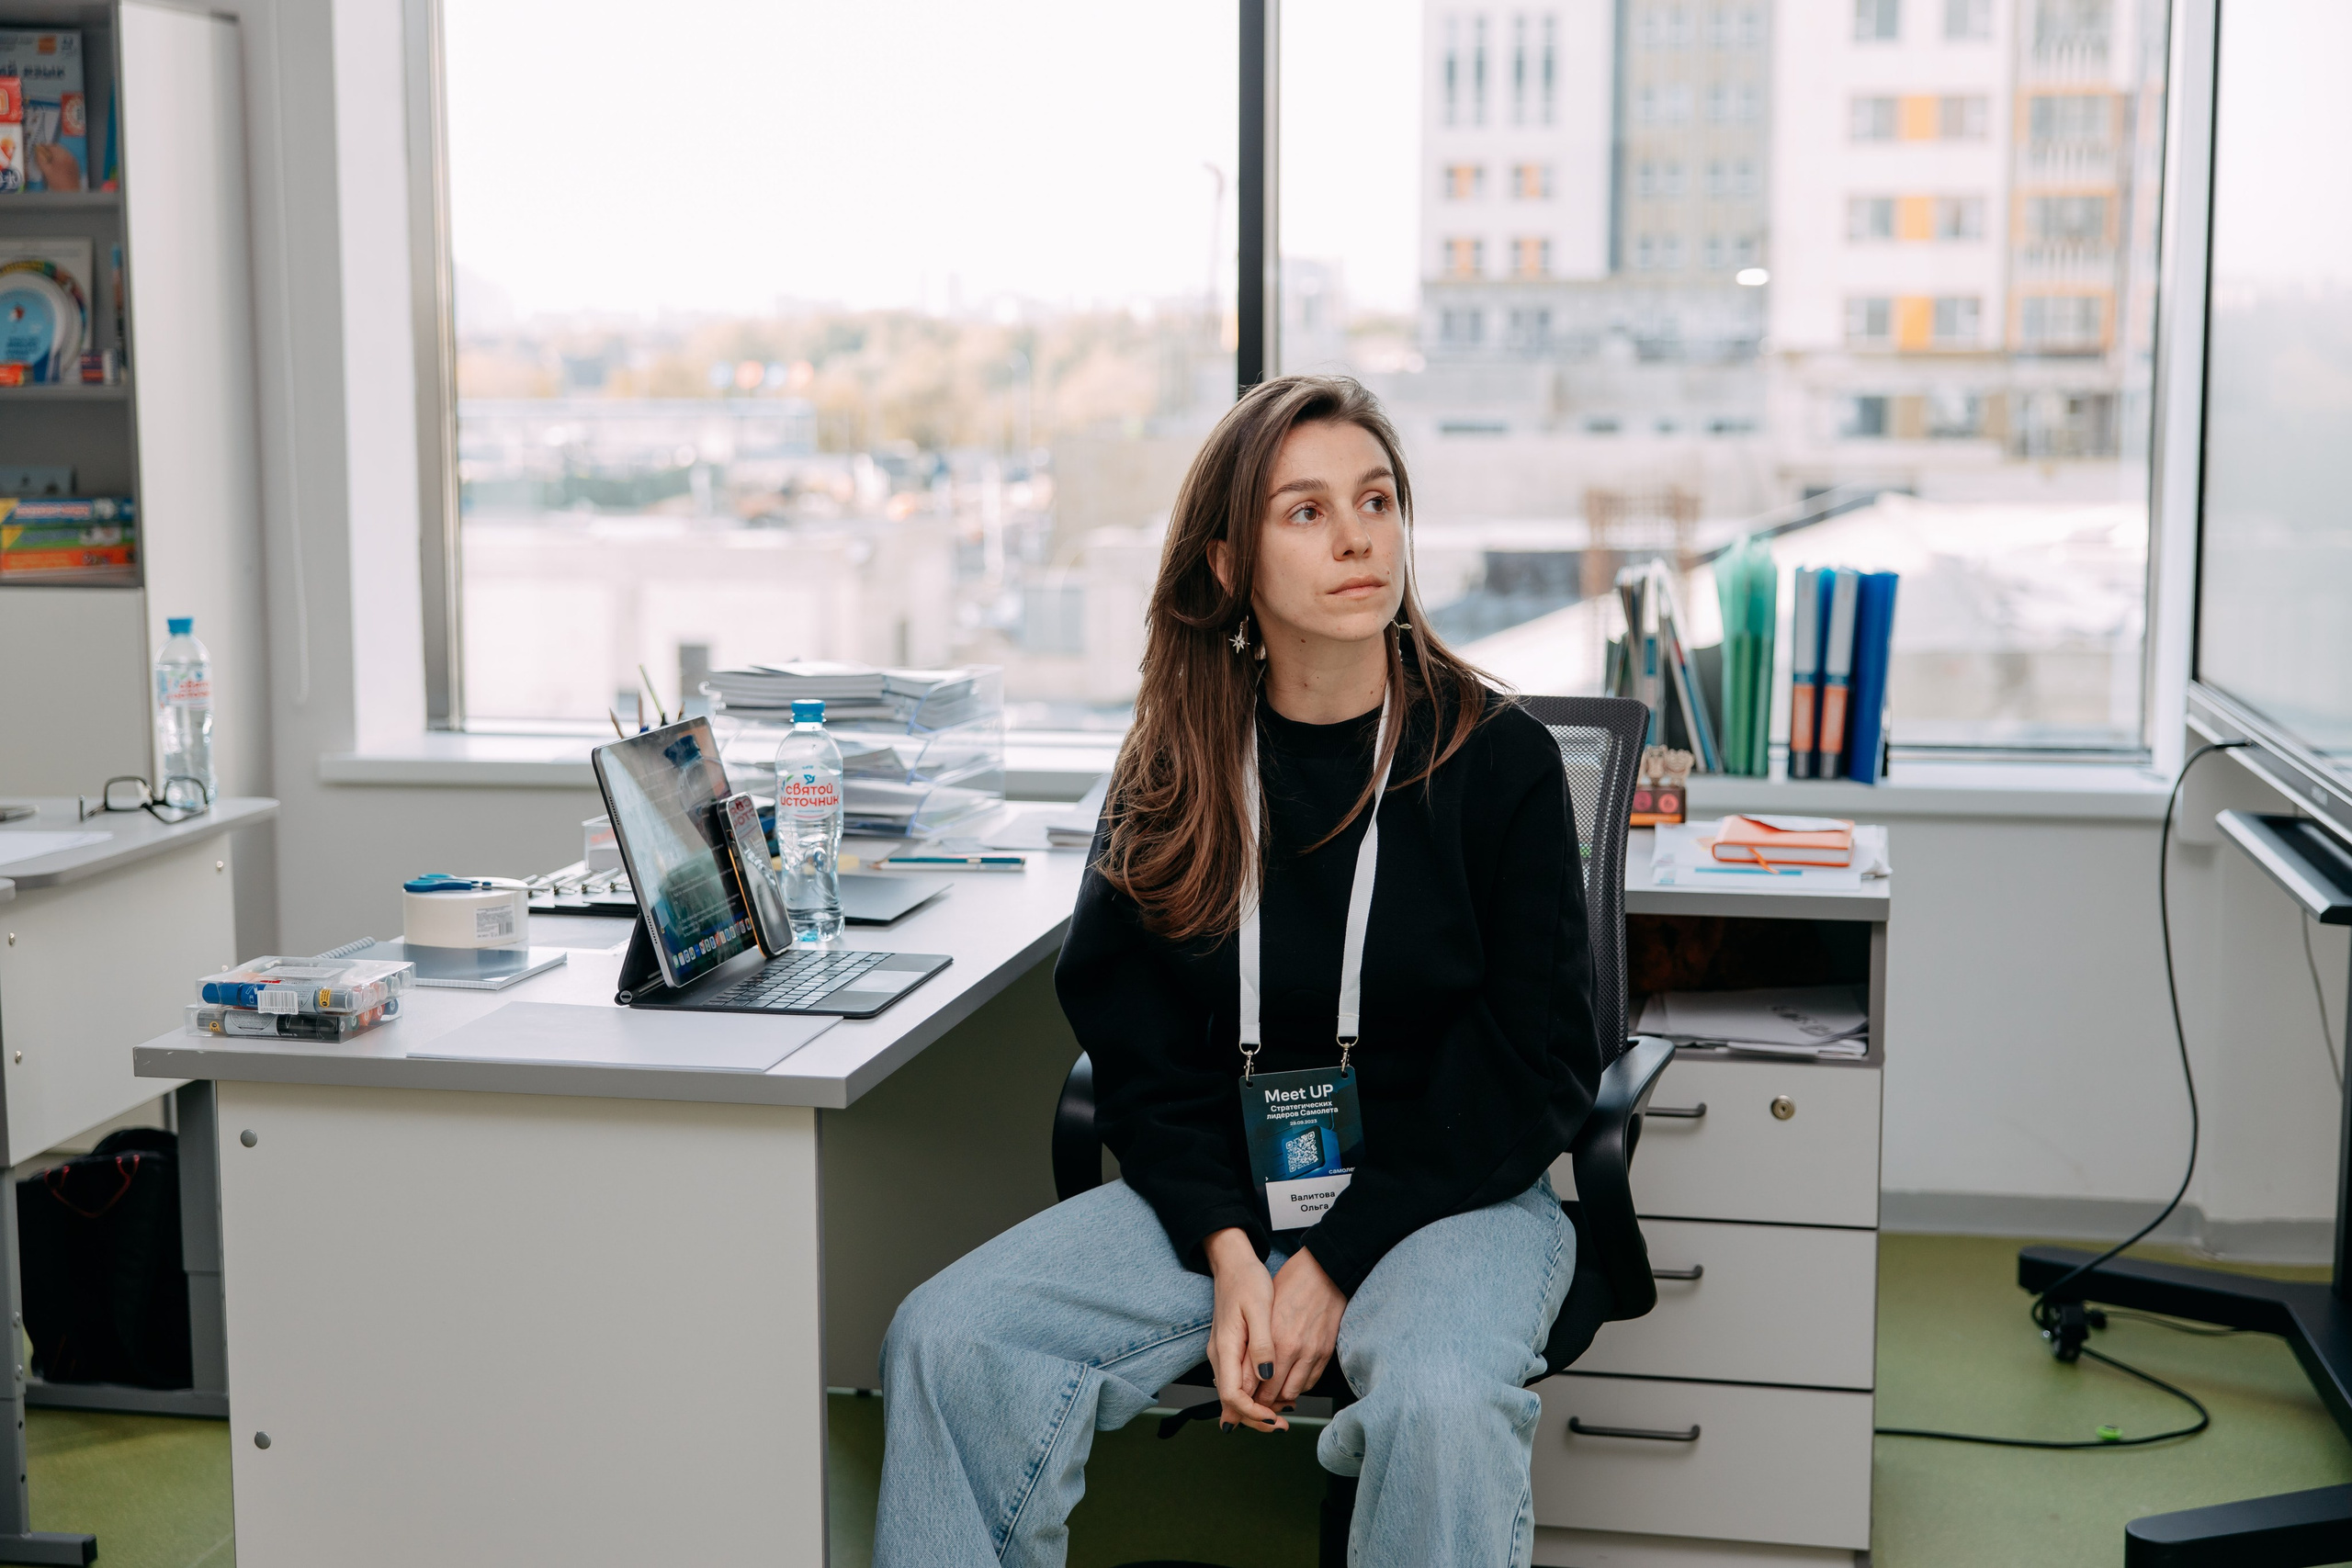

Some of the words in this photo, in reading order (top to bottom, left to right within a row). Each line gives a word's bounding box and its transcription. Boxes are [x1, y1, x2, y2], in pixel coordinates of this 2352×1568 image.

[1264, 1089, 1306, 1103] Meet
[1309, 1084, 1334, 1099] UP
[1270, 1100, 1333, 1112] Стратегических
[1266, 1111, 1299, 1120] лидеров
[1299, 1107, 1339, 1116] Самолета
[1329, 1167, 1355, 1175] самоле
[1291, 1191, 1335, 1201] Валитова
[1300, 1203, 1329, 1212] Ольга
